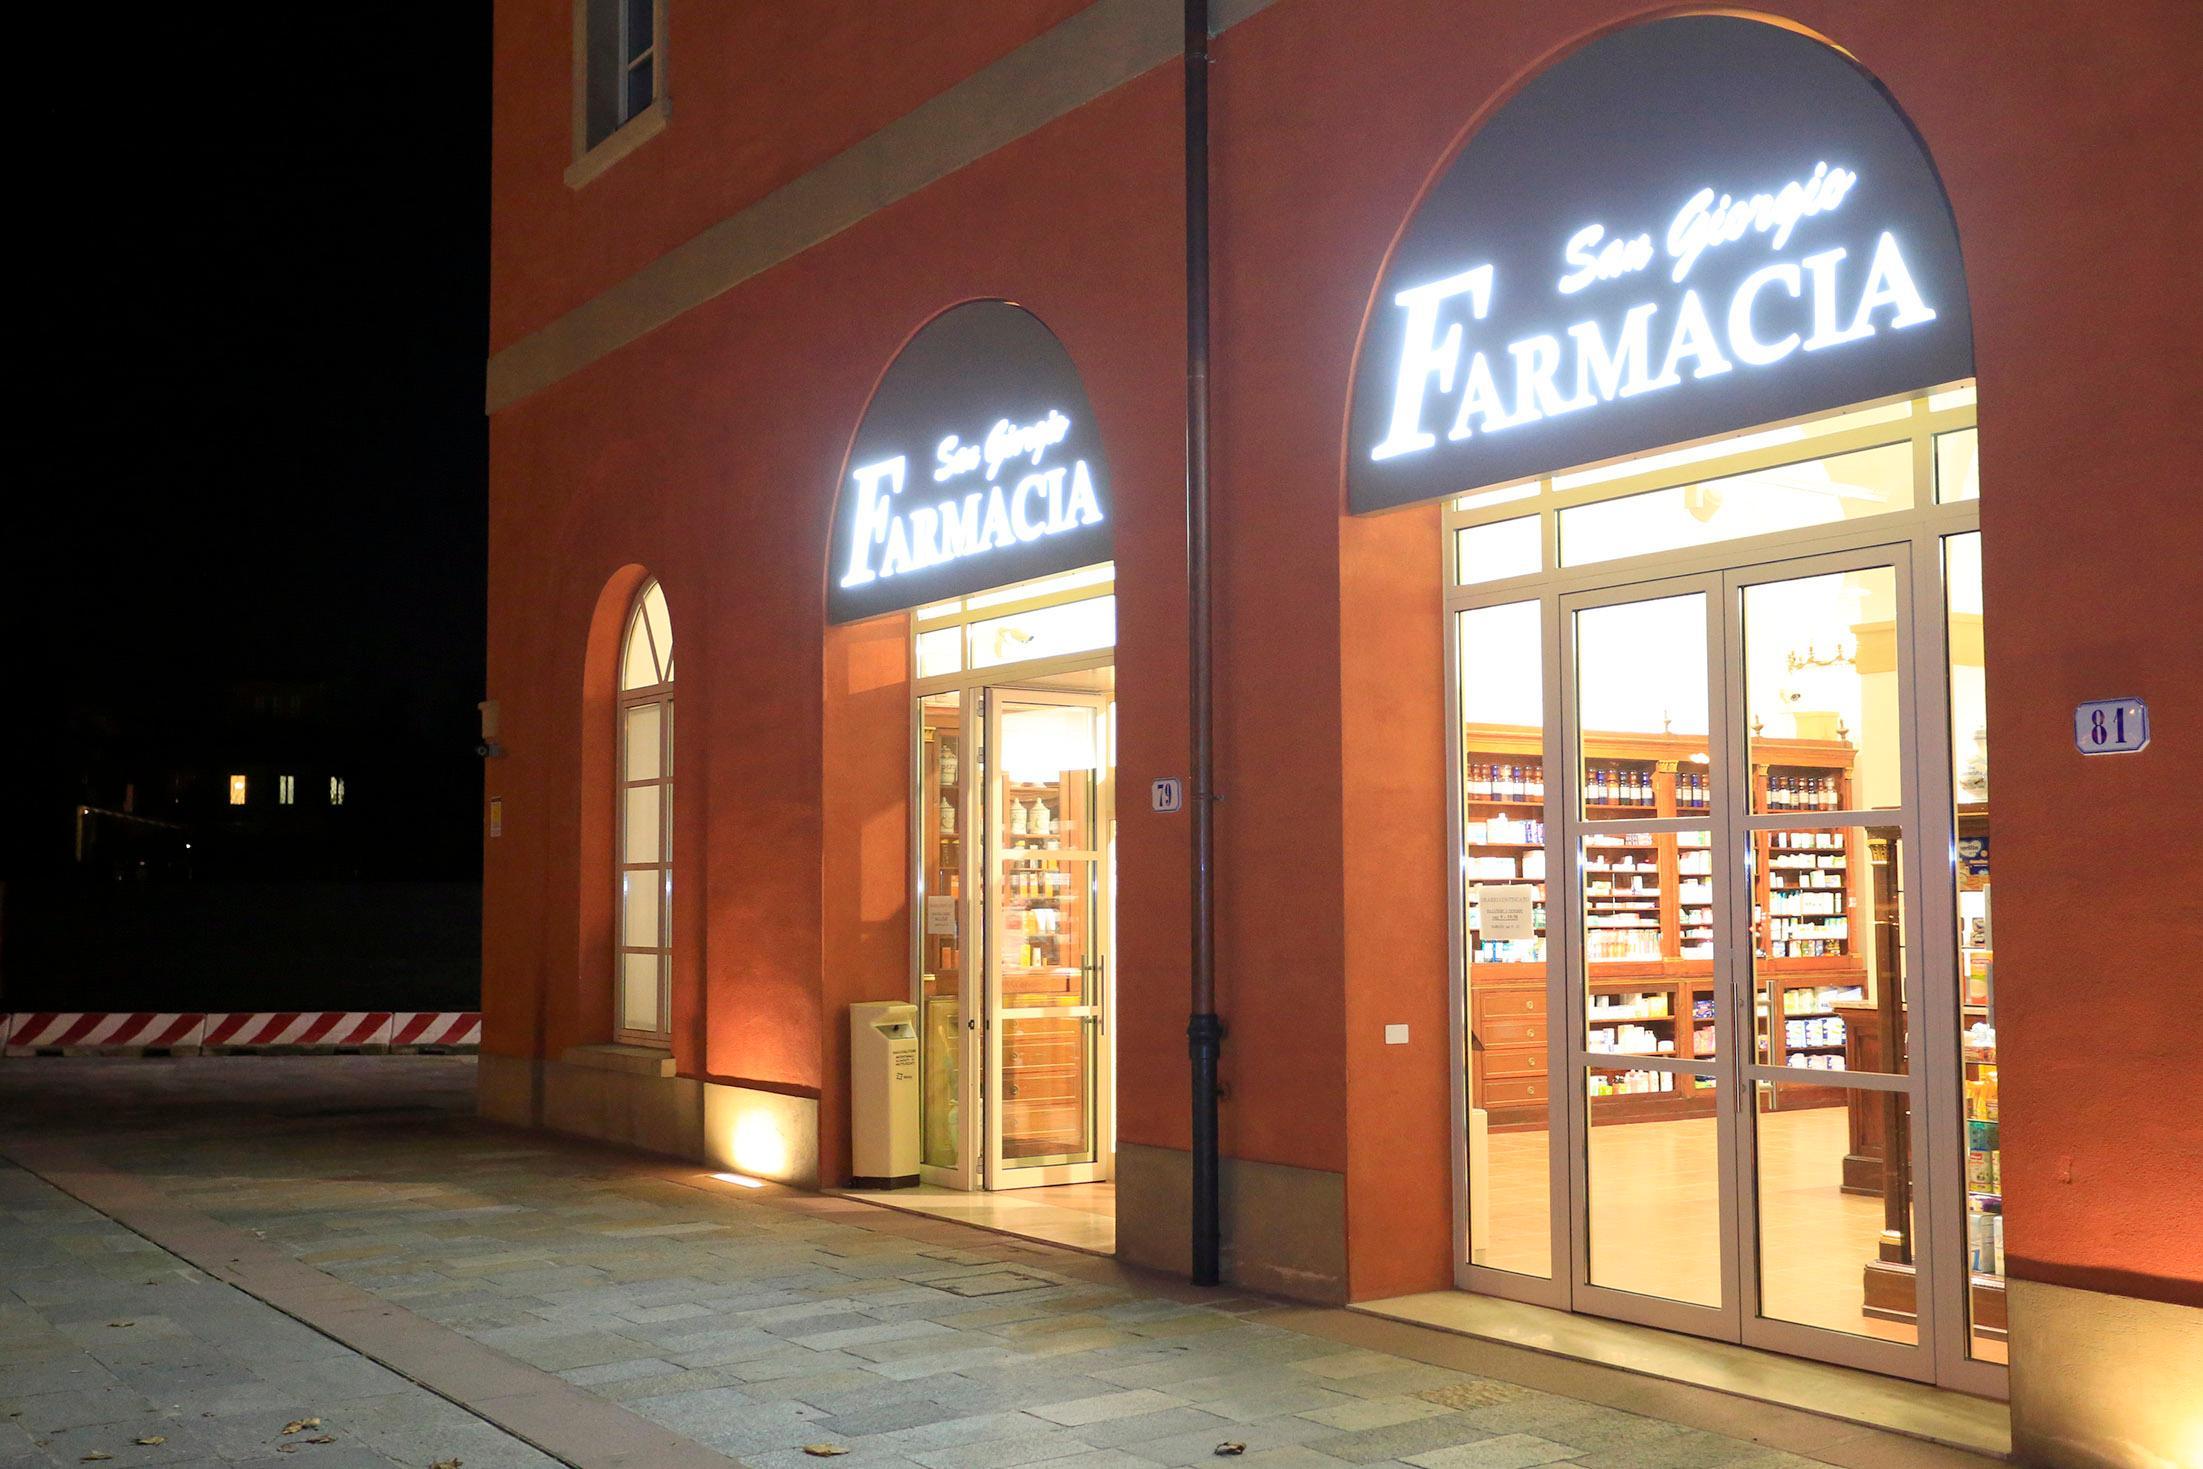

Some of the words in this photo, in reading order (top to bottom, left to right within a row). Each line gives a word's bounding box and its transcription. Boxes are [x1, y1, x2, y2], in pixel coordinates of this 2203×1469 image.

[1558, 223, 1655, 295] San
[1666, 161, 1857, 283] Giorgio
[1371, 231, 1937, 461] FARMACIA
[933, 435, 982, 482] San
[983, 409, 1070, 481] Giorgio
[840, 455, 1104, 588] FARMACIA
[2091, 707, 2127, 746] 81
[1157, 783, 1172, 807] 79
